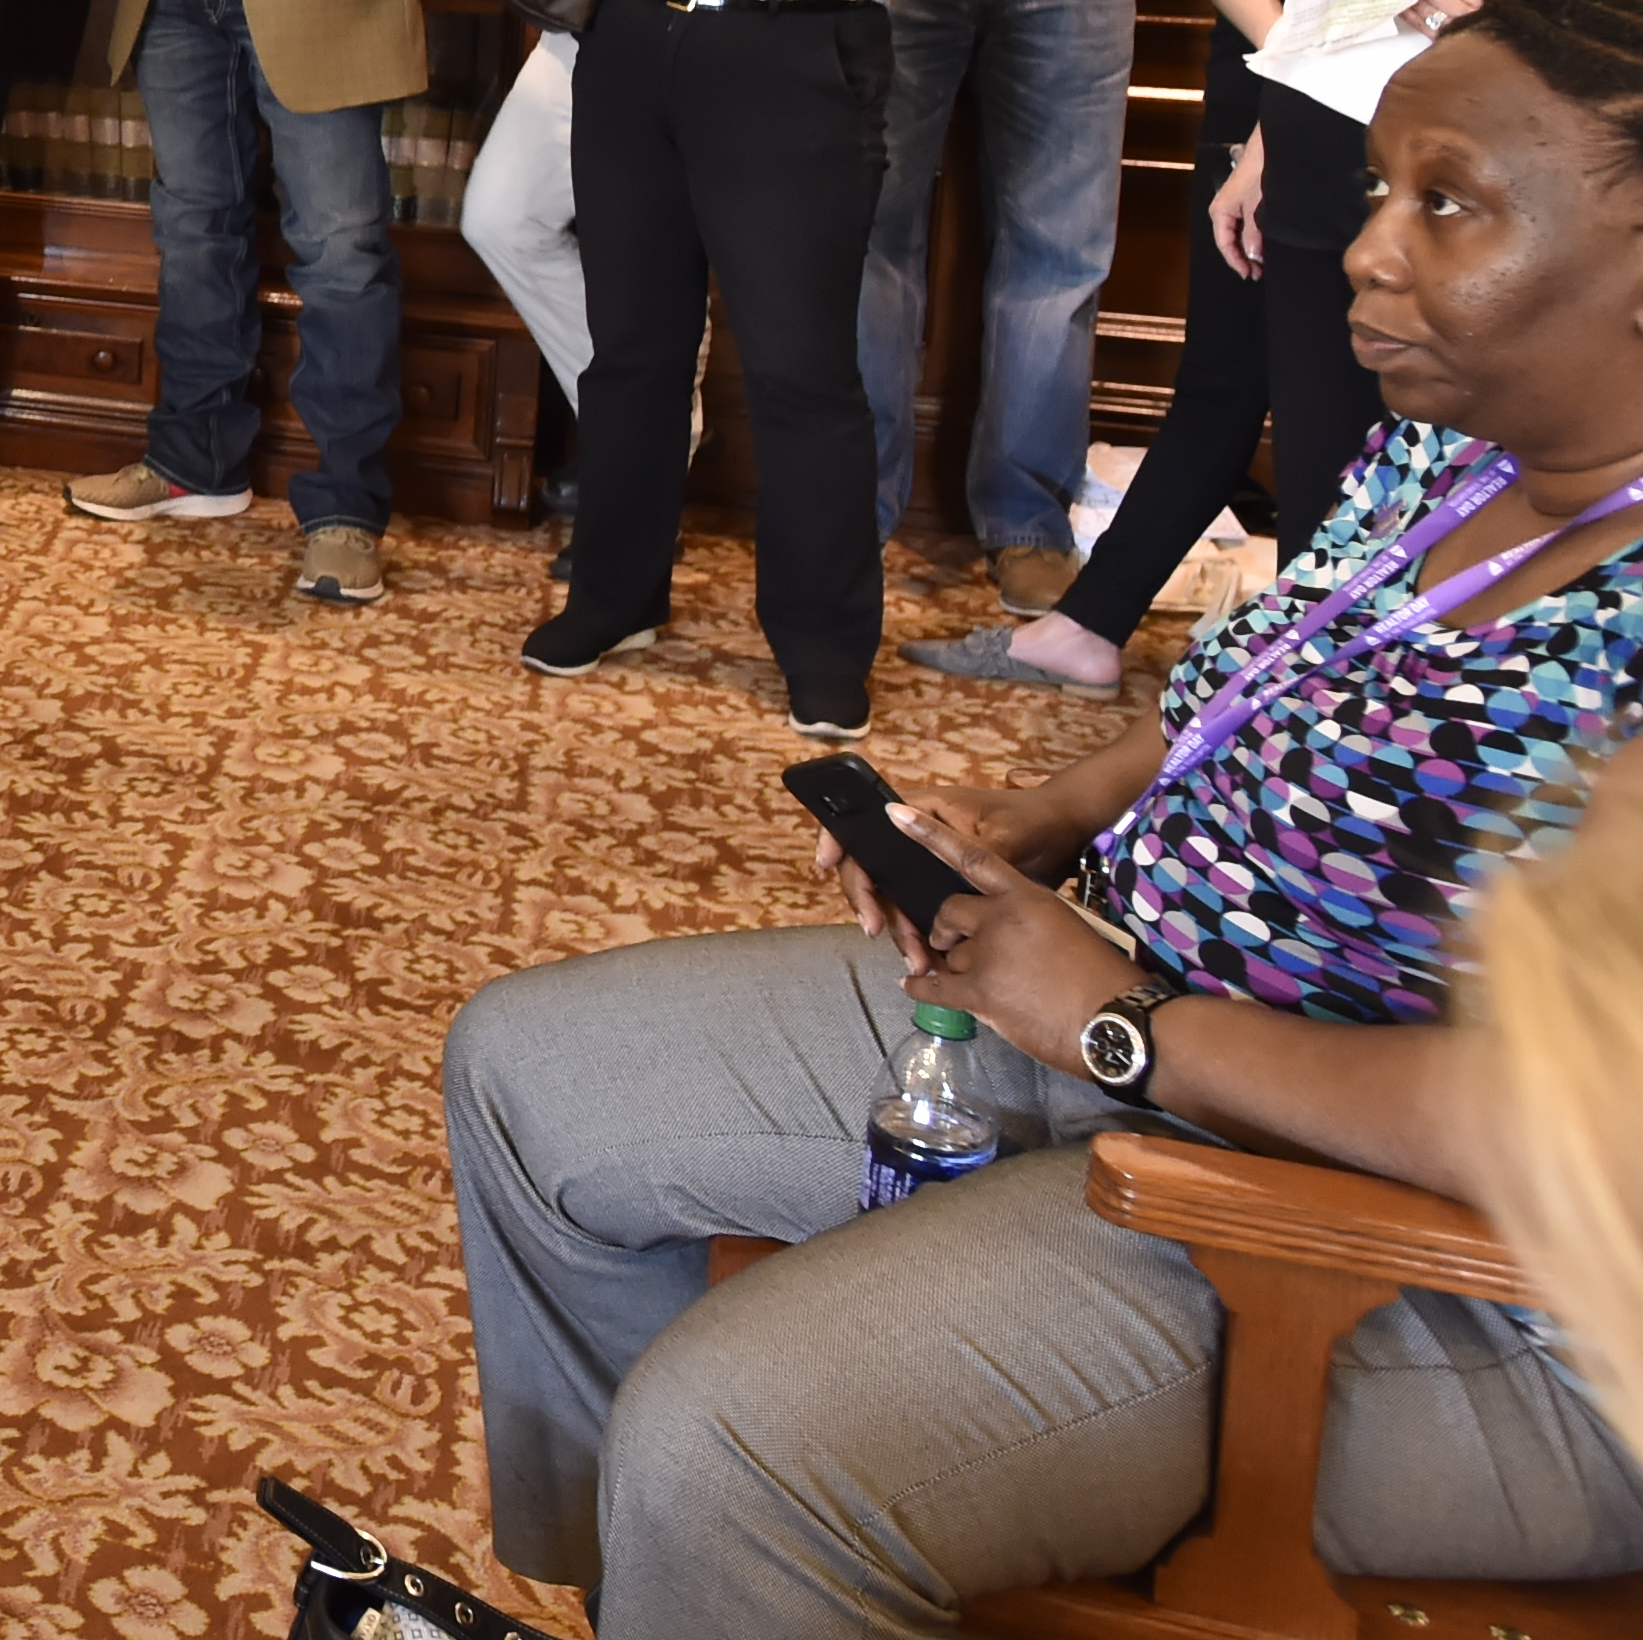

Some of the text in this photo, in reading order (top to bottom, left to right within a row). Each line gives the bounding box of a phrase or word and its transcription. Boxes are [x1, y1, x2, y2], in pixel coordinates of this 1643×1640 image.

[1455, 500, 1475, 518] DAY
[1349, 584, 1368, 600] DAY
[1373, 606, 1414, 634] REALTOR
[1409, 596, 1430, 614] DAY
[1186, 732, 1206, 750] DAY
